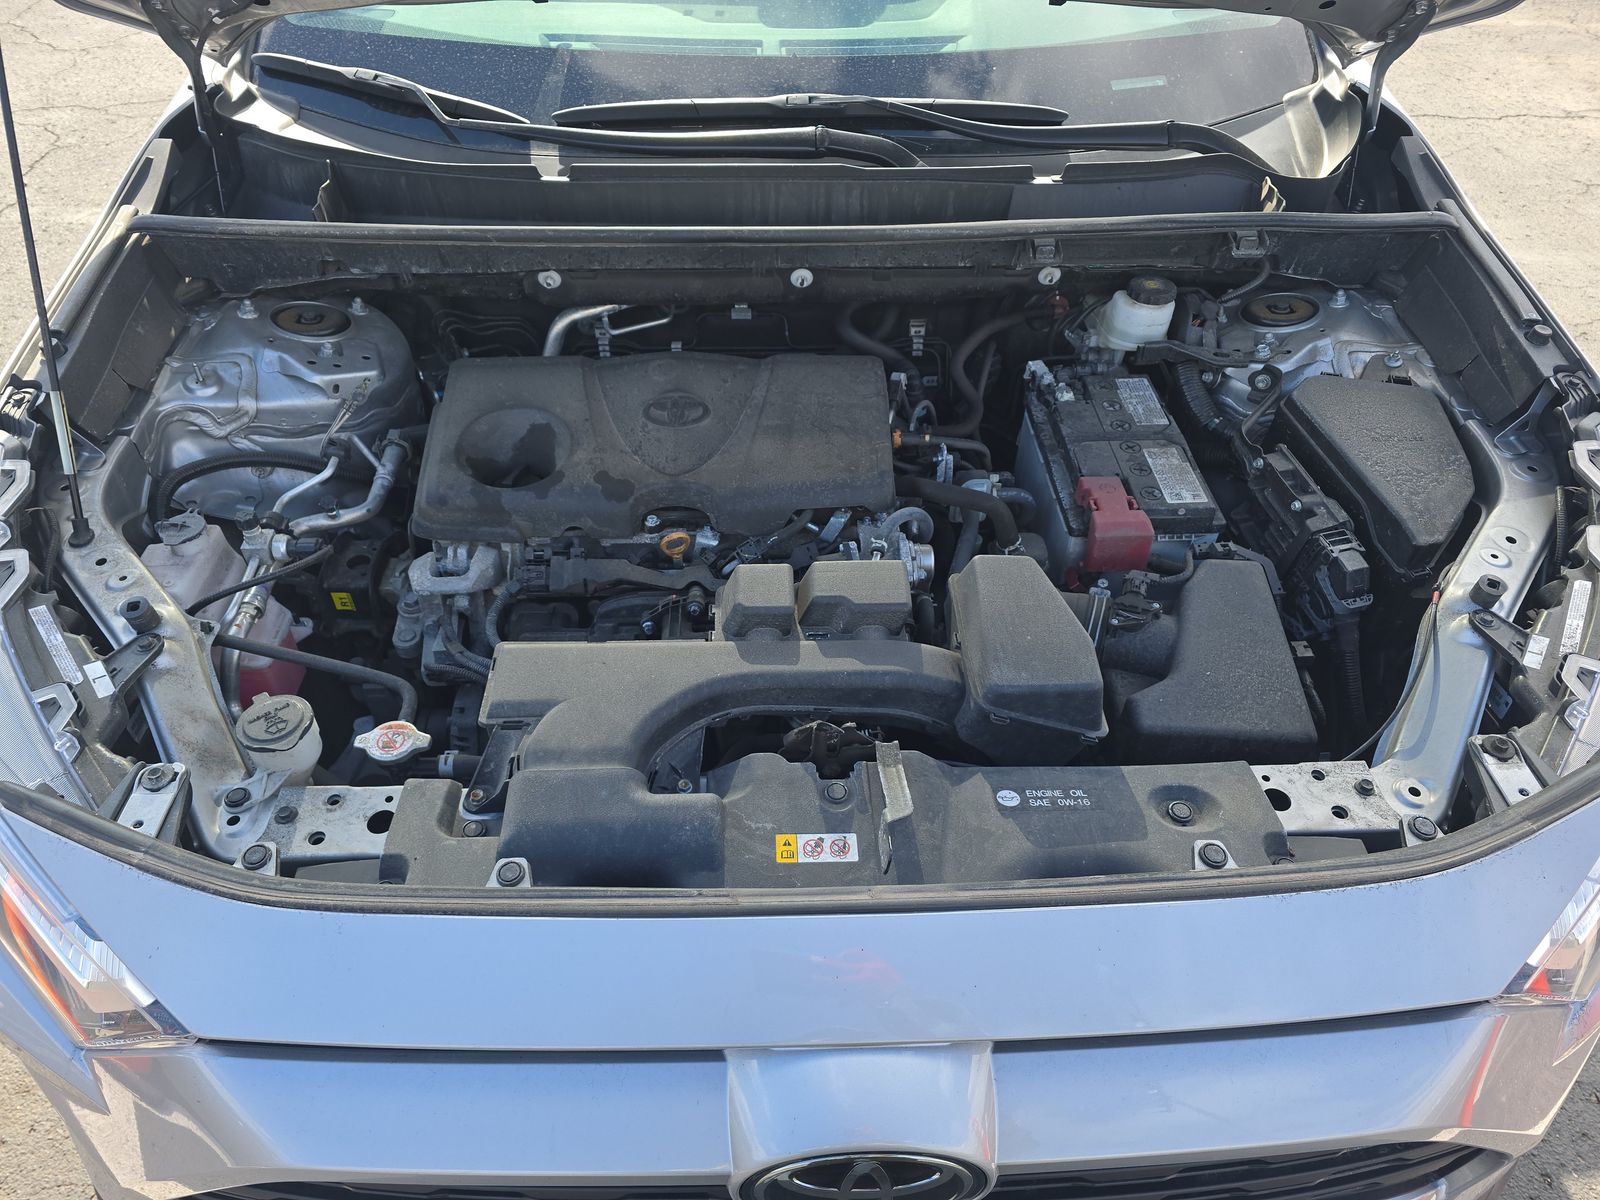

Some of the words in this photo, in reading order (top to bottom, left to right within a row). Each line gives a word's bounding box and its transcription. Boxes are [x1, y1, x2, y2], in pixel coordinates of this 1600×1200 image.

[1025, 789, 1064, 798] ENGINE
[1069, 789, 1088, 797] OIL
[1028, 798, 1051, 807] SAE
[1057, 798, 1091, 807] 0W-16
